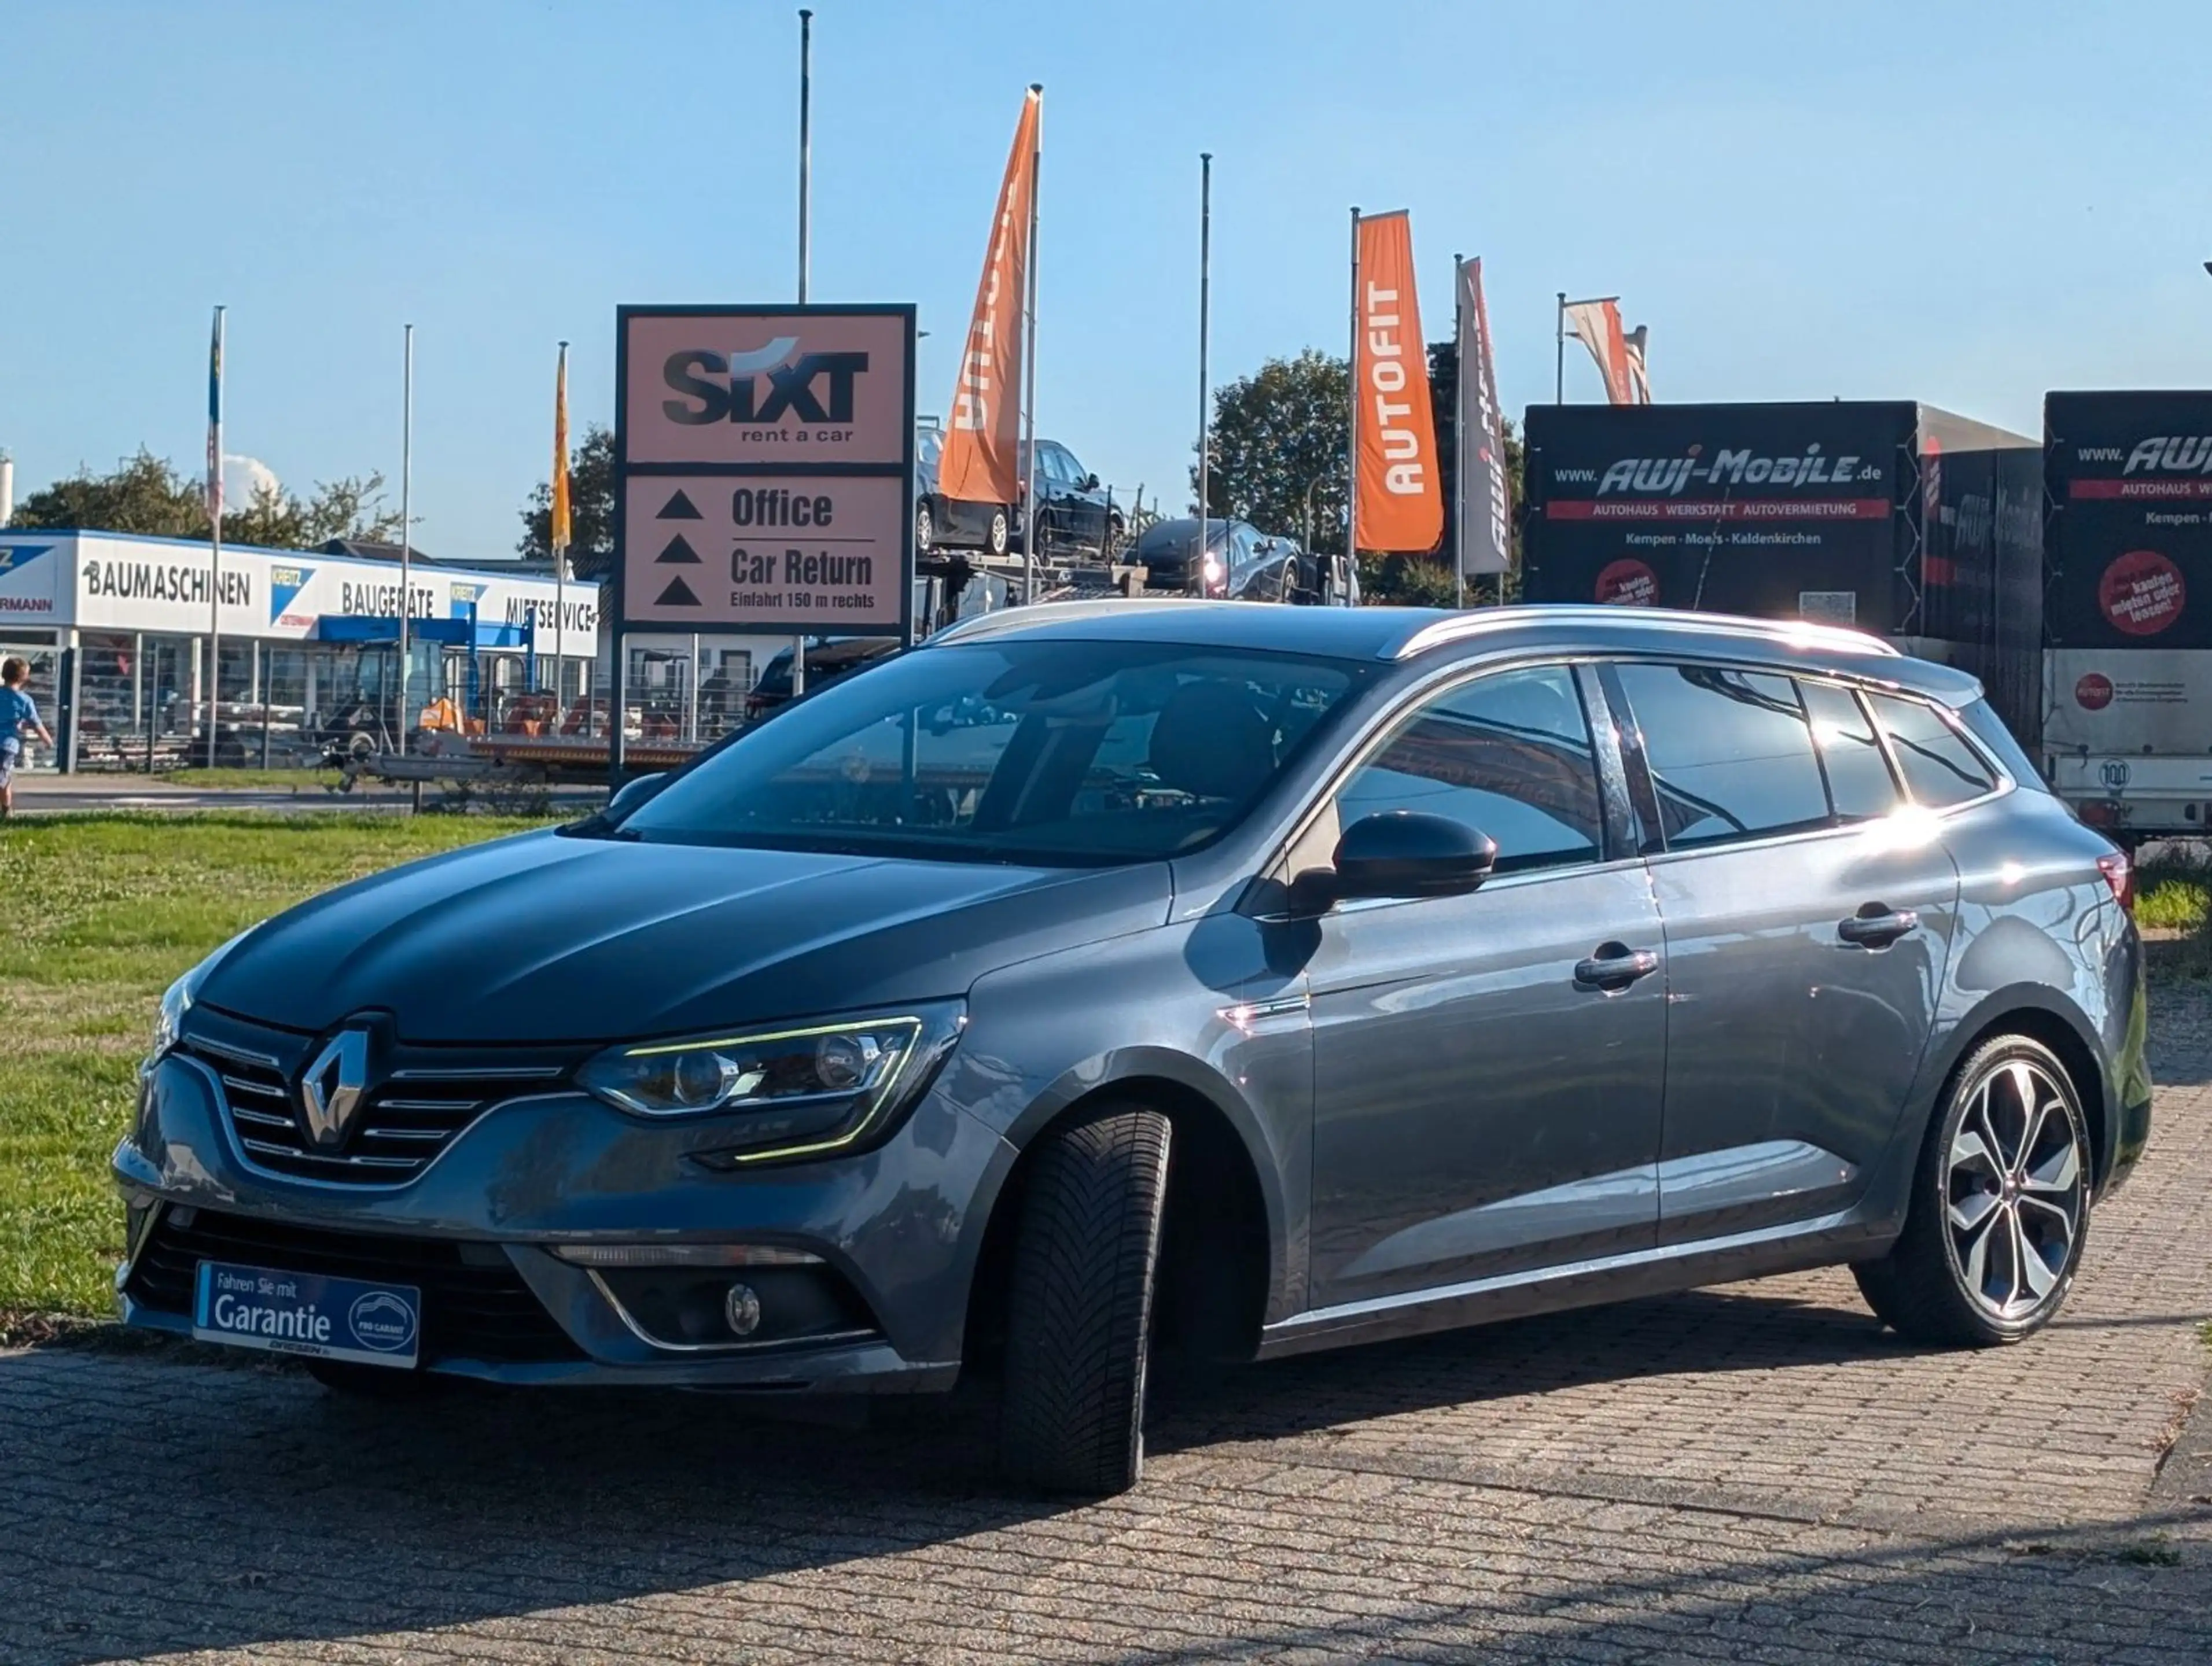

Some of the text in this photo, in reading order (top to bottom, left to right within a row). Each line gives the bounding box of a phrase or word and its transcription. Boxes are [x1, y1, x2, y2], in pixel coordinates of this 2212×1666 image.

[1368, 281, 1424, 494] AUTOFIT
[742, 429, 853, 442] rent a car
[2122, 483, 2191, 495] AUTOHAUS
[733, 488, 833, 526] Office
[1593, 503, 1857, 515] AUTOHAUS WERKSTATT AUTOVERMIETUNG
[2145, 512, 2200, 526] Kempen
[1626, 533, 1676, 548] Kempen
[1732, 532, 1821, 544] Kaldenkirchen
[731, 548, 873, 585] Car Return
[89, 560, 250, 606] BAUMASCHINEN
[731, 591, 875, 608] Einfahrt 150 m rechts
[2103, 764, 2127, 786] 100
[218, 1273, 296, 1299] Fahren Sie mit
[215, 1293, 331, 1341] Garantie
